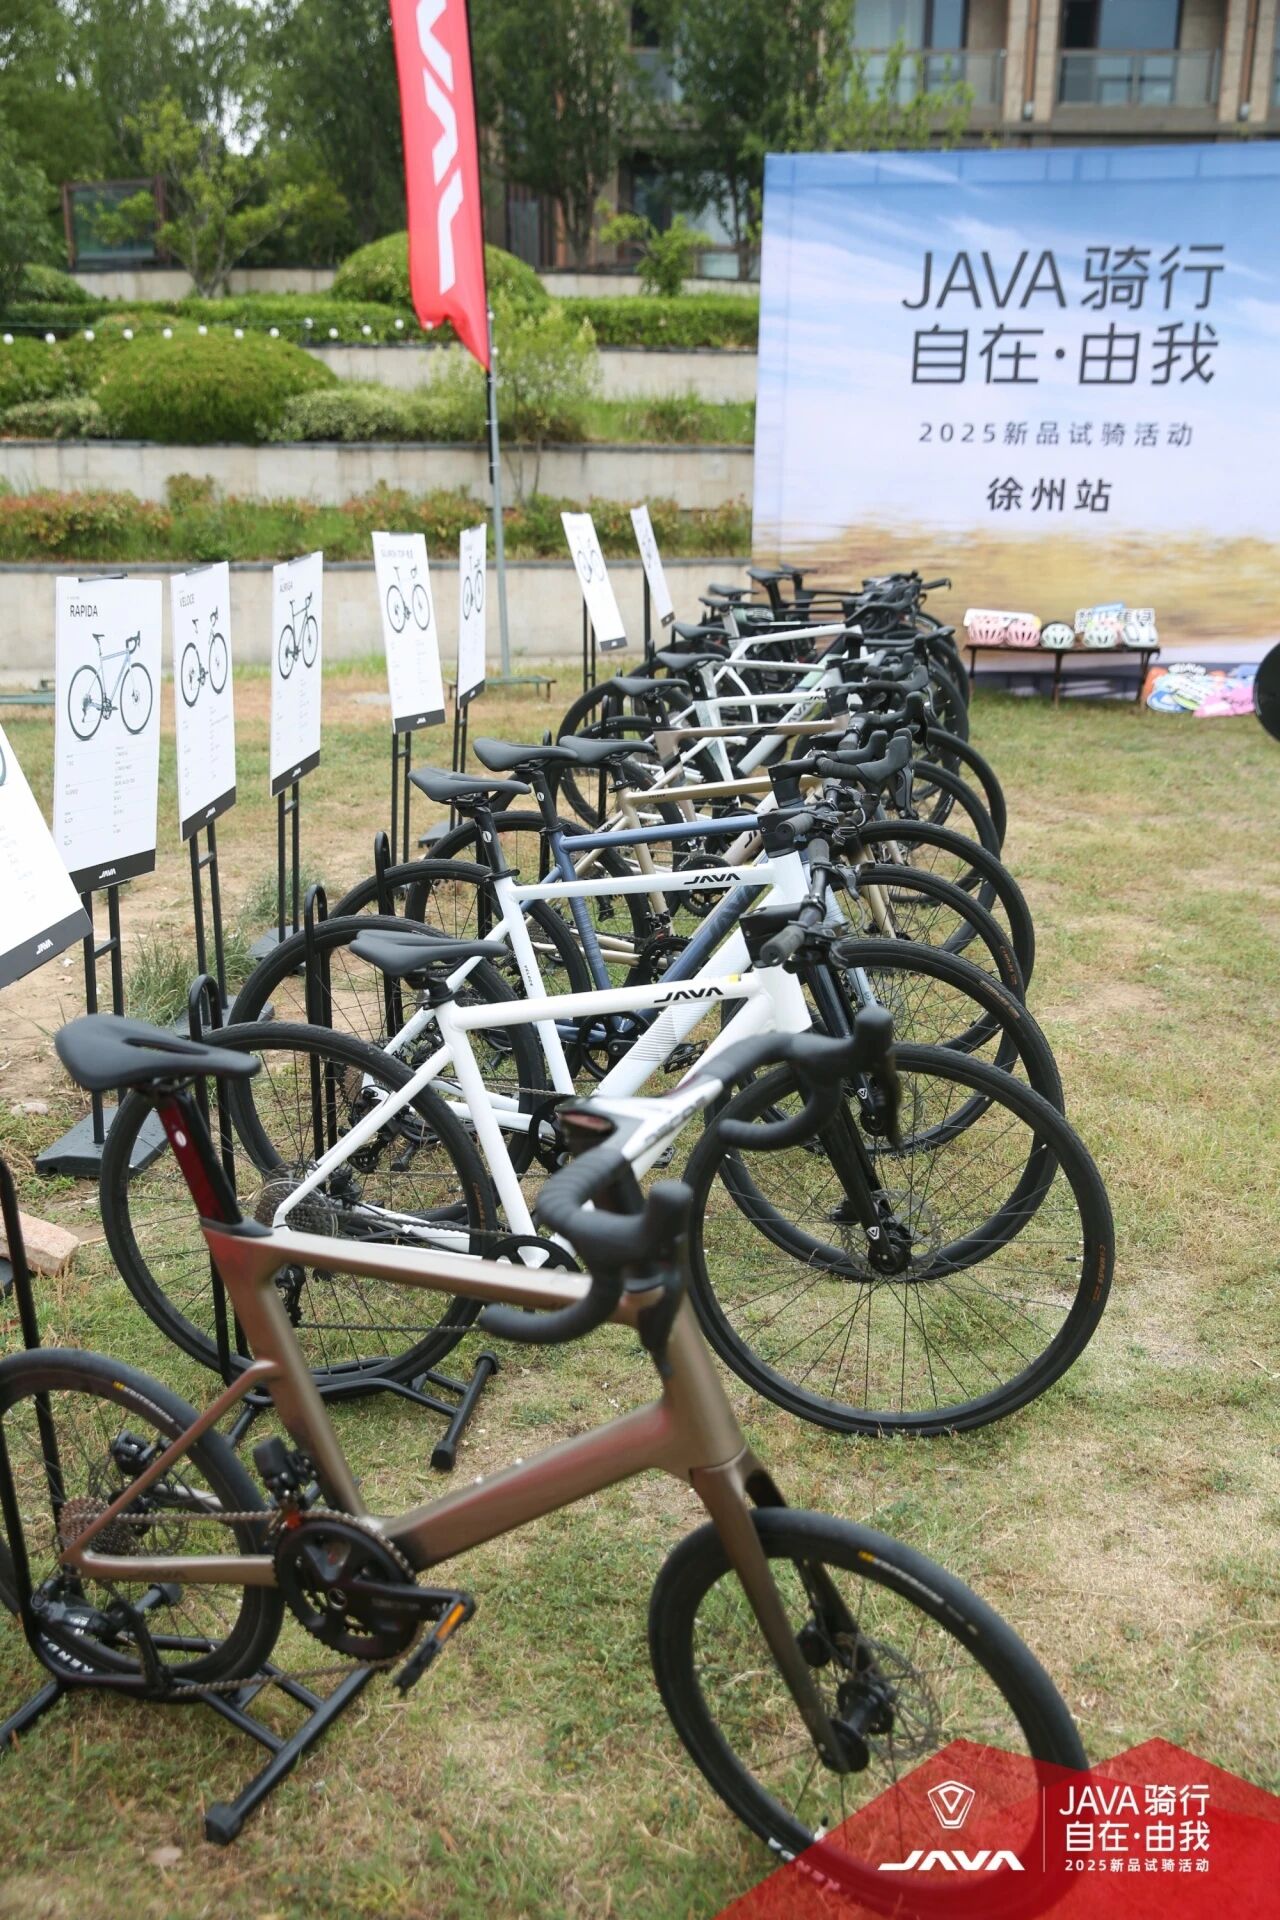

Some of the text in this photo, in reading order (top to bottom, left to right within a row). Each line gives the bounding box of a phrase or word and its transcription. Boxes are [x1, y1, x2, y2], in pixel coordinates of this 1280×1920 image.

[902, 243, 1225, 311] JAVA 骑行
[911, 321, 1219, 385] 自在·由我
[918, 421, 1193, 448] 2025新品试骑活动
[986, 476, 1113, 512] 徐州站
[69, 604, 98, 618] RAPIDA
[683, 872, 741, 885] JAVA
[653, 986, 724, 1003] JAVA
